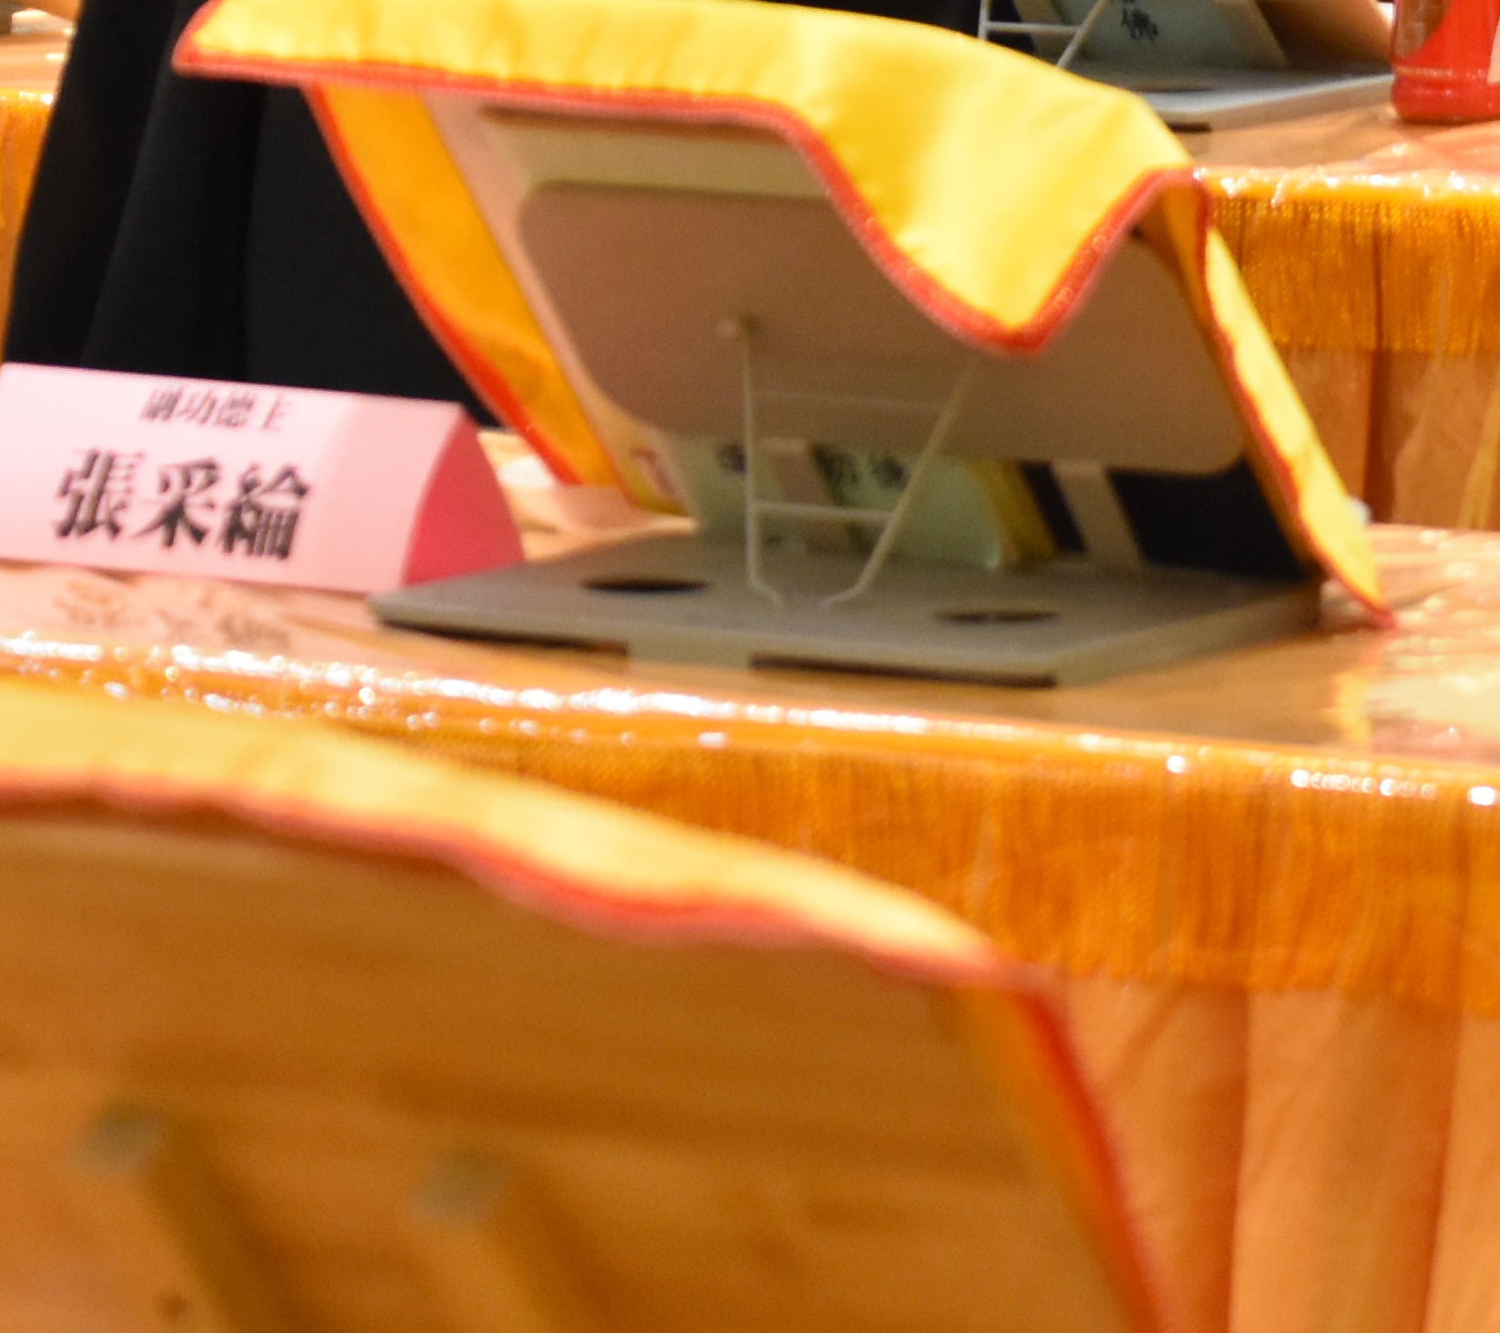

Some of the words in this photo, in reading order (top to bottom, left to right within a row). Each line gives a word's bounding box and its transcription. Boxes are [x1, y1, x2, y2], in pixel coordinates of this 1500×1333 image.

[139, 384, 294, 434] 副功德主
[54, 446, 313, 561] 張采綸
